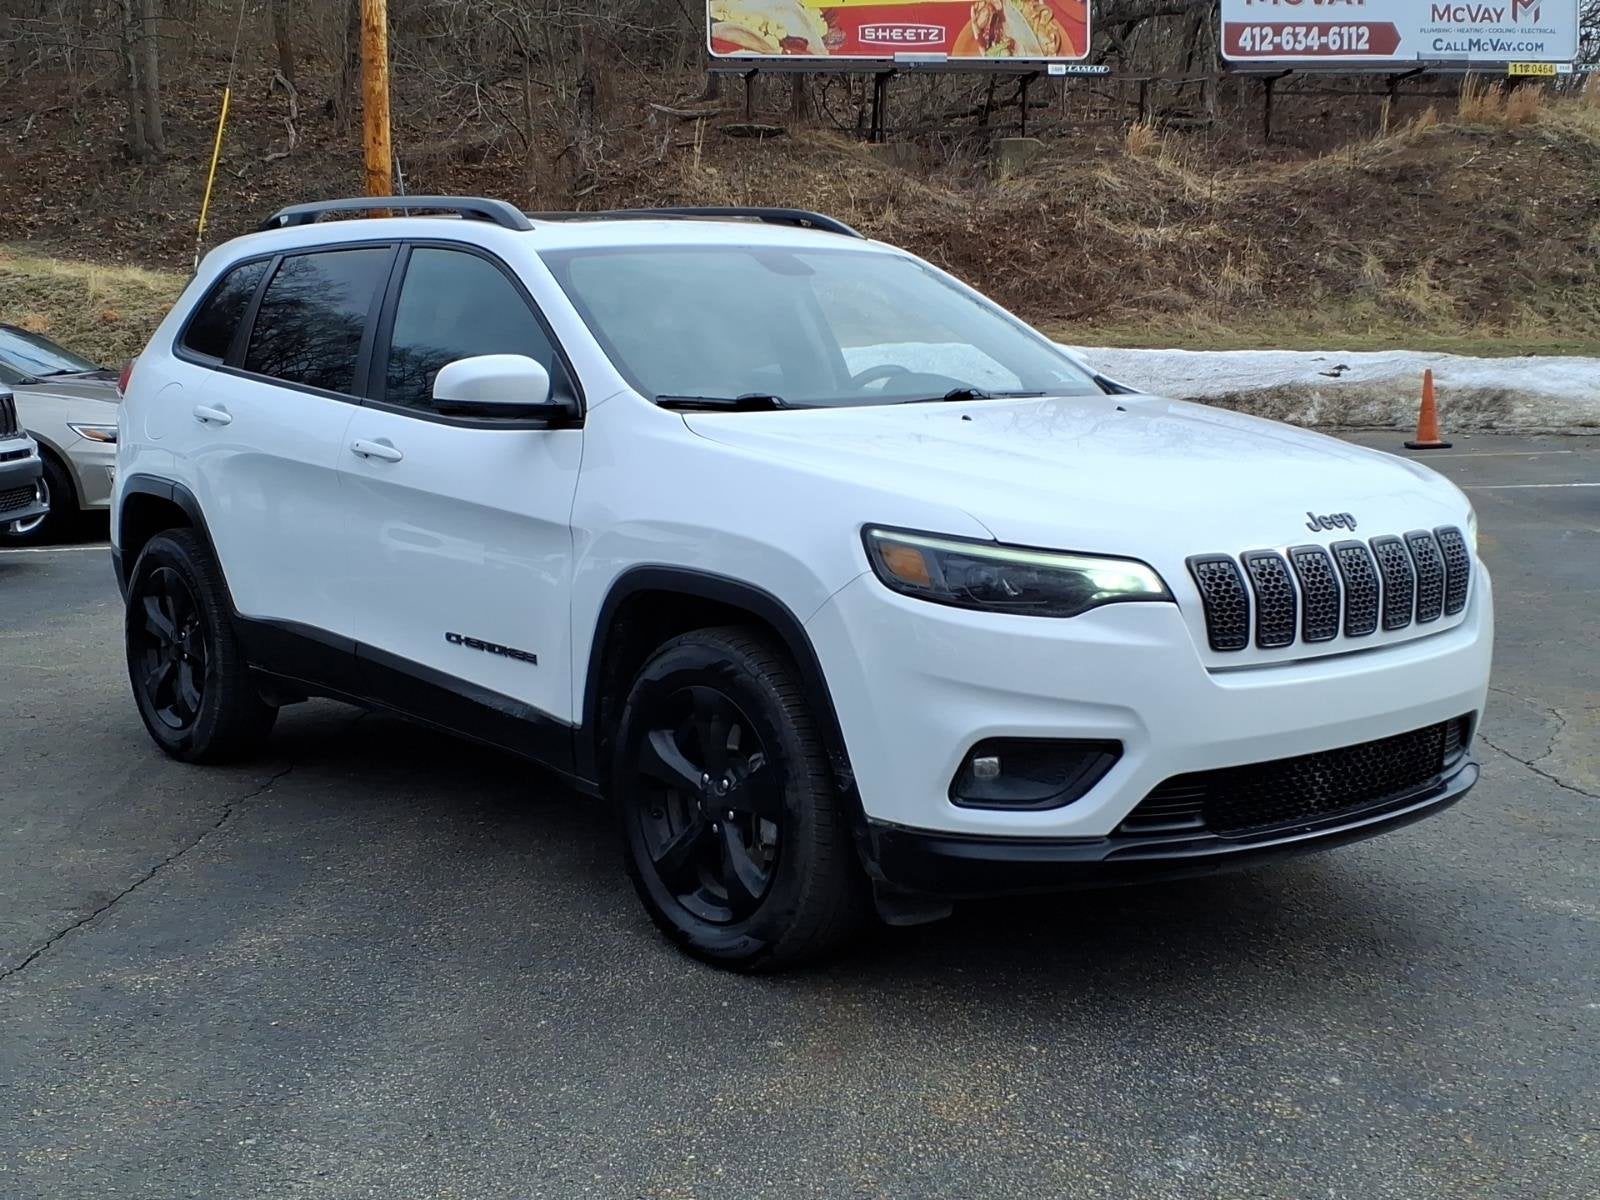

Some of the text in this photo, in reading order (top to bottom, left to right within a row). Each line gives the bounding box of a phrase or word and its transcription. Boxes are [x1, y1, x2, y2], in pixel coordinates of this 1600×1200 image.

[864, 27, 939, 41] SHEETZ
[1238, 26, 1370, 51] 412-634-6112
[1305, 511, 1357, 532] Jeep
[445, 631, 538, 666] CHEROKEE
